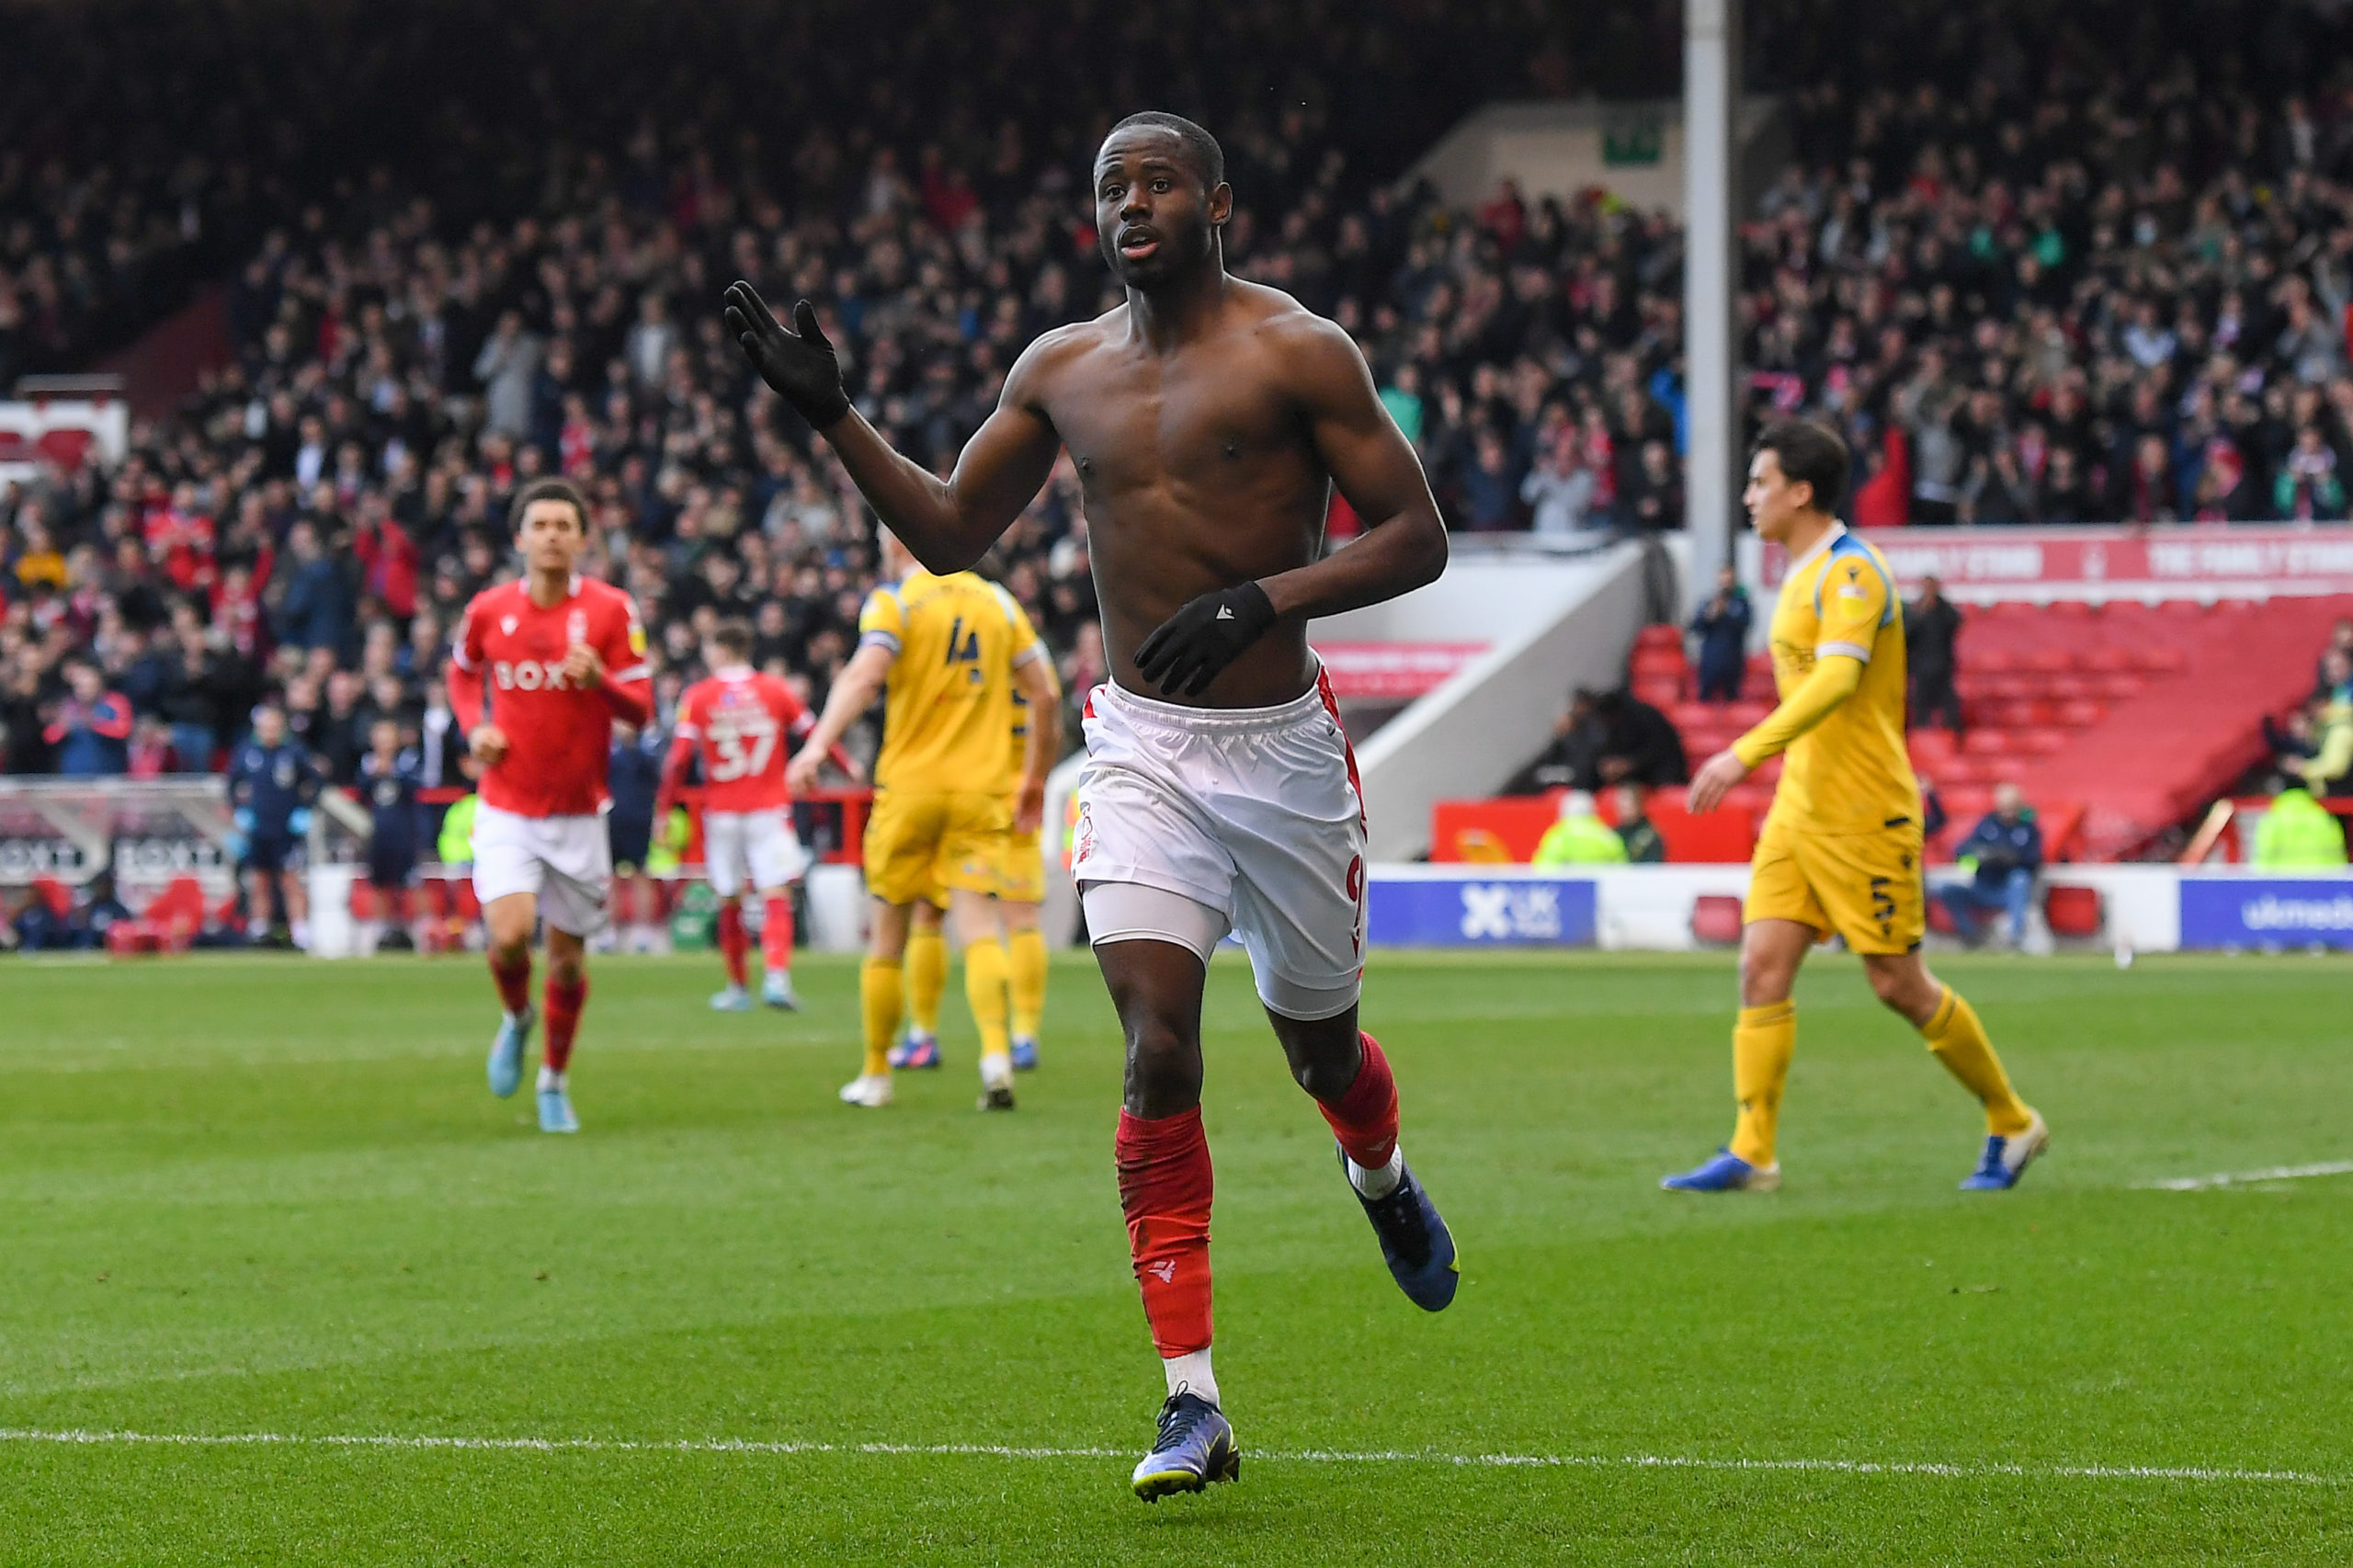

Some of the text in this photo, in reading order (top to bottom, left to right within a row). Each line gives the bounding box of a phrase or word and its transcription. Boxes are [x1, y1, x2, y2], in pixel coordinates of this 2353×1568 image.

[945, 616, 982, 683] 4
[707, 717, 779, 781] 37
[1870, 876, 1895, 921] 5
